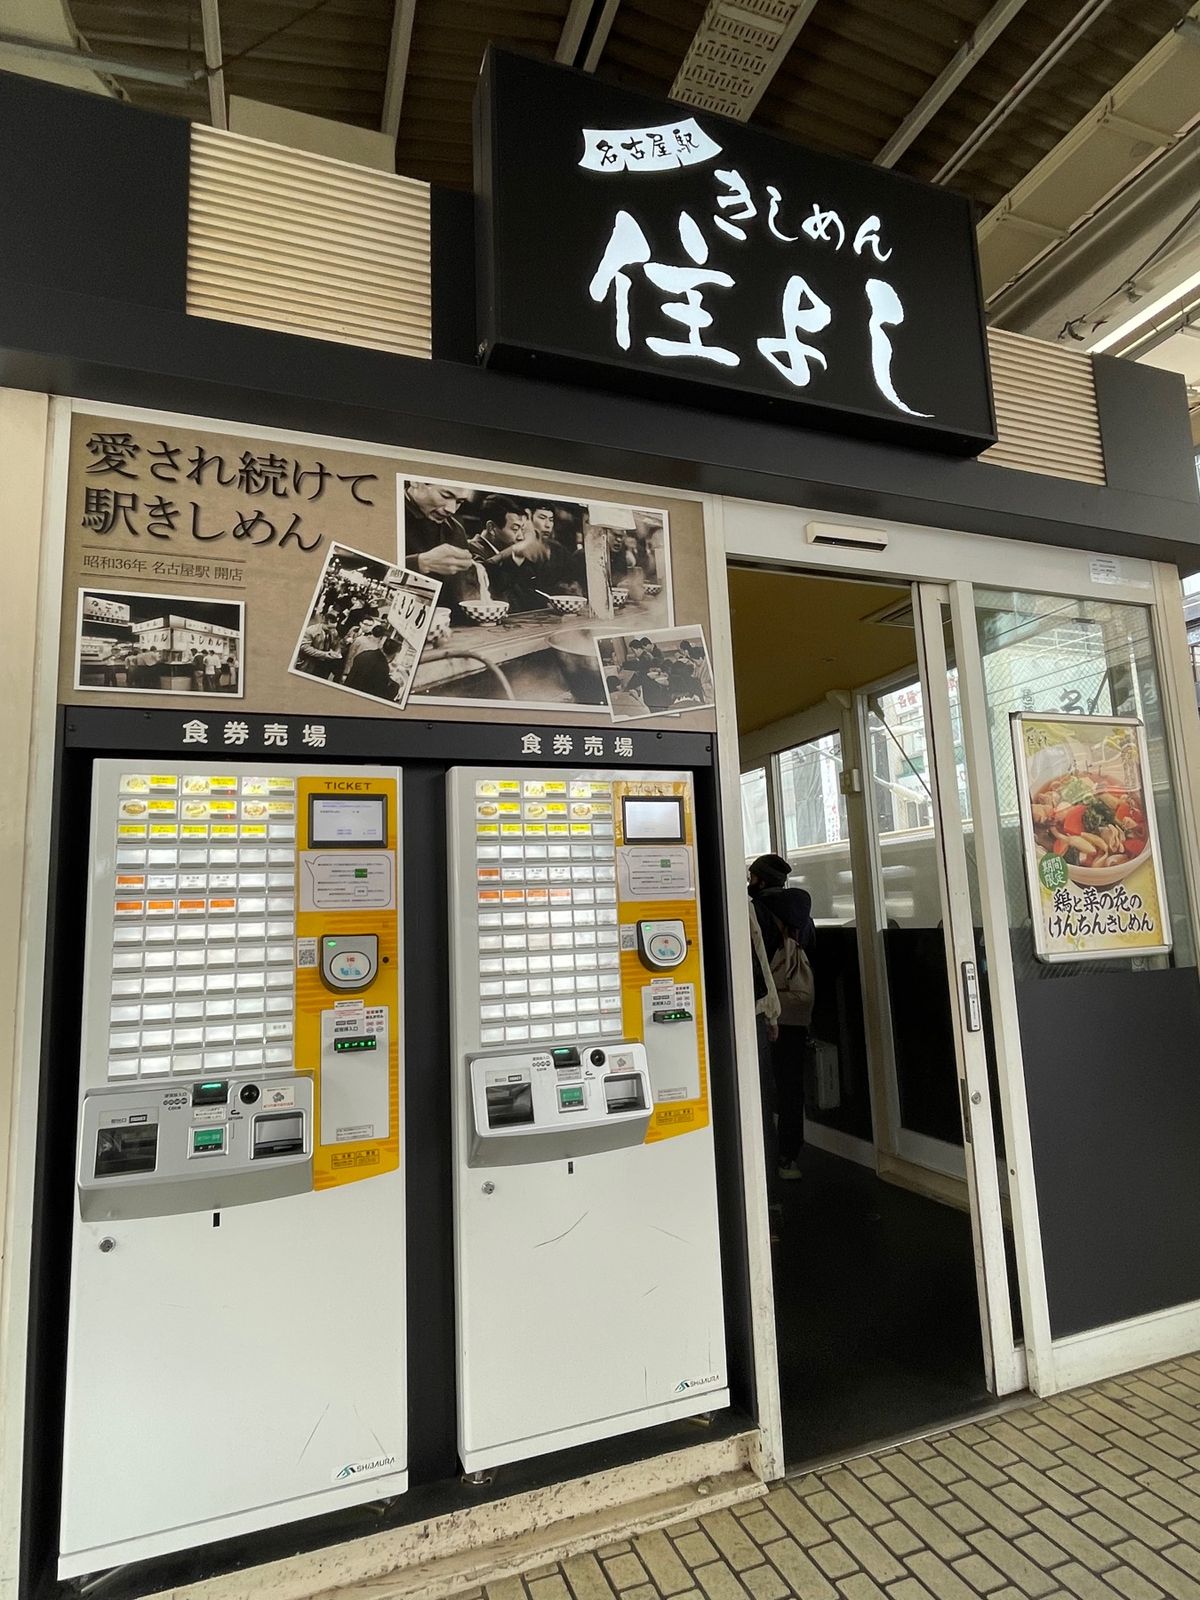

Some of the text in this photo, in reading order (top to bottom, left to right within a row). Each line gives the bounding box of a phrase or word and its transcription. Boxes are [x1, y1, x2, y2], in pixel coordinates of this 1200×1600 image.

[595, 129, 700, 167] 名古屋駅
[713, 169, 892, 262] きしめん
[589, 210, 936, 418] 住よし
[85, 432, 379, 506] 愛され続けて
[81, 486, 325, 552] 駅きしめん
[82, 555, 243, 581] 昭和36年 名古屋駅 開店
[182, 719, 327, 748] 食券売場
[521, 732, 634, 757] 食券売場
[324, 781, 372, 791] TICKET
[1042, 856, 1063, 875] 期間
[1044, 870, 1066, 888] 限定
[1054, 886, 1142, 913] 鶏と菜の花の
[1048, 911, 1154, 938] けんちんきしめん
